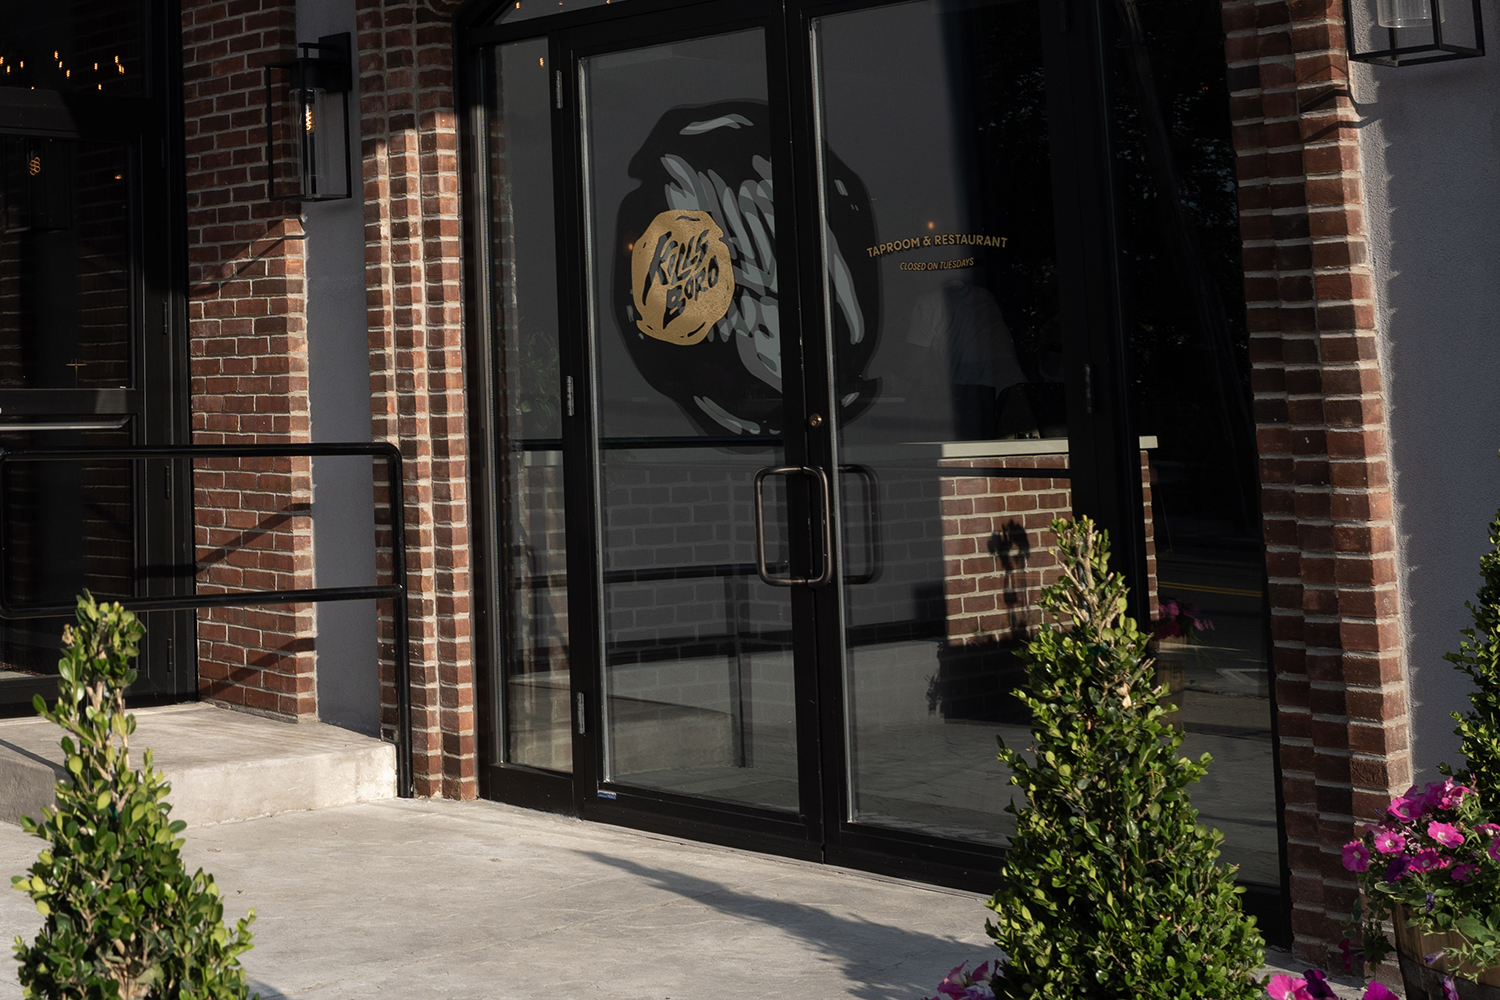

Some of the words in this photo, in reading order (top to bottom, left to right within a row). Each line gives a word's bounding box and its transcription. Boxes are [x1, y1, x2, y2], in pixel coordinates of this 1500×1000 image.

[642, 229, 710, 306] KILLS
[866, 236, 920, 258] TAPROOM
[922, 235, 932, 247] &
[934, 233, 1008, 249] RESTAURANT
[899, 261, 927, 271] CLOSED
[927, 261, 938, 271] ON
[939, 257, 975, 270] TUESDAYS
[662, 254, 719, 330] BORO
